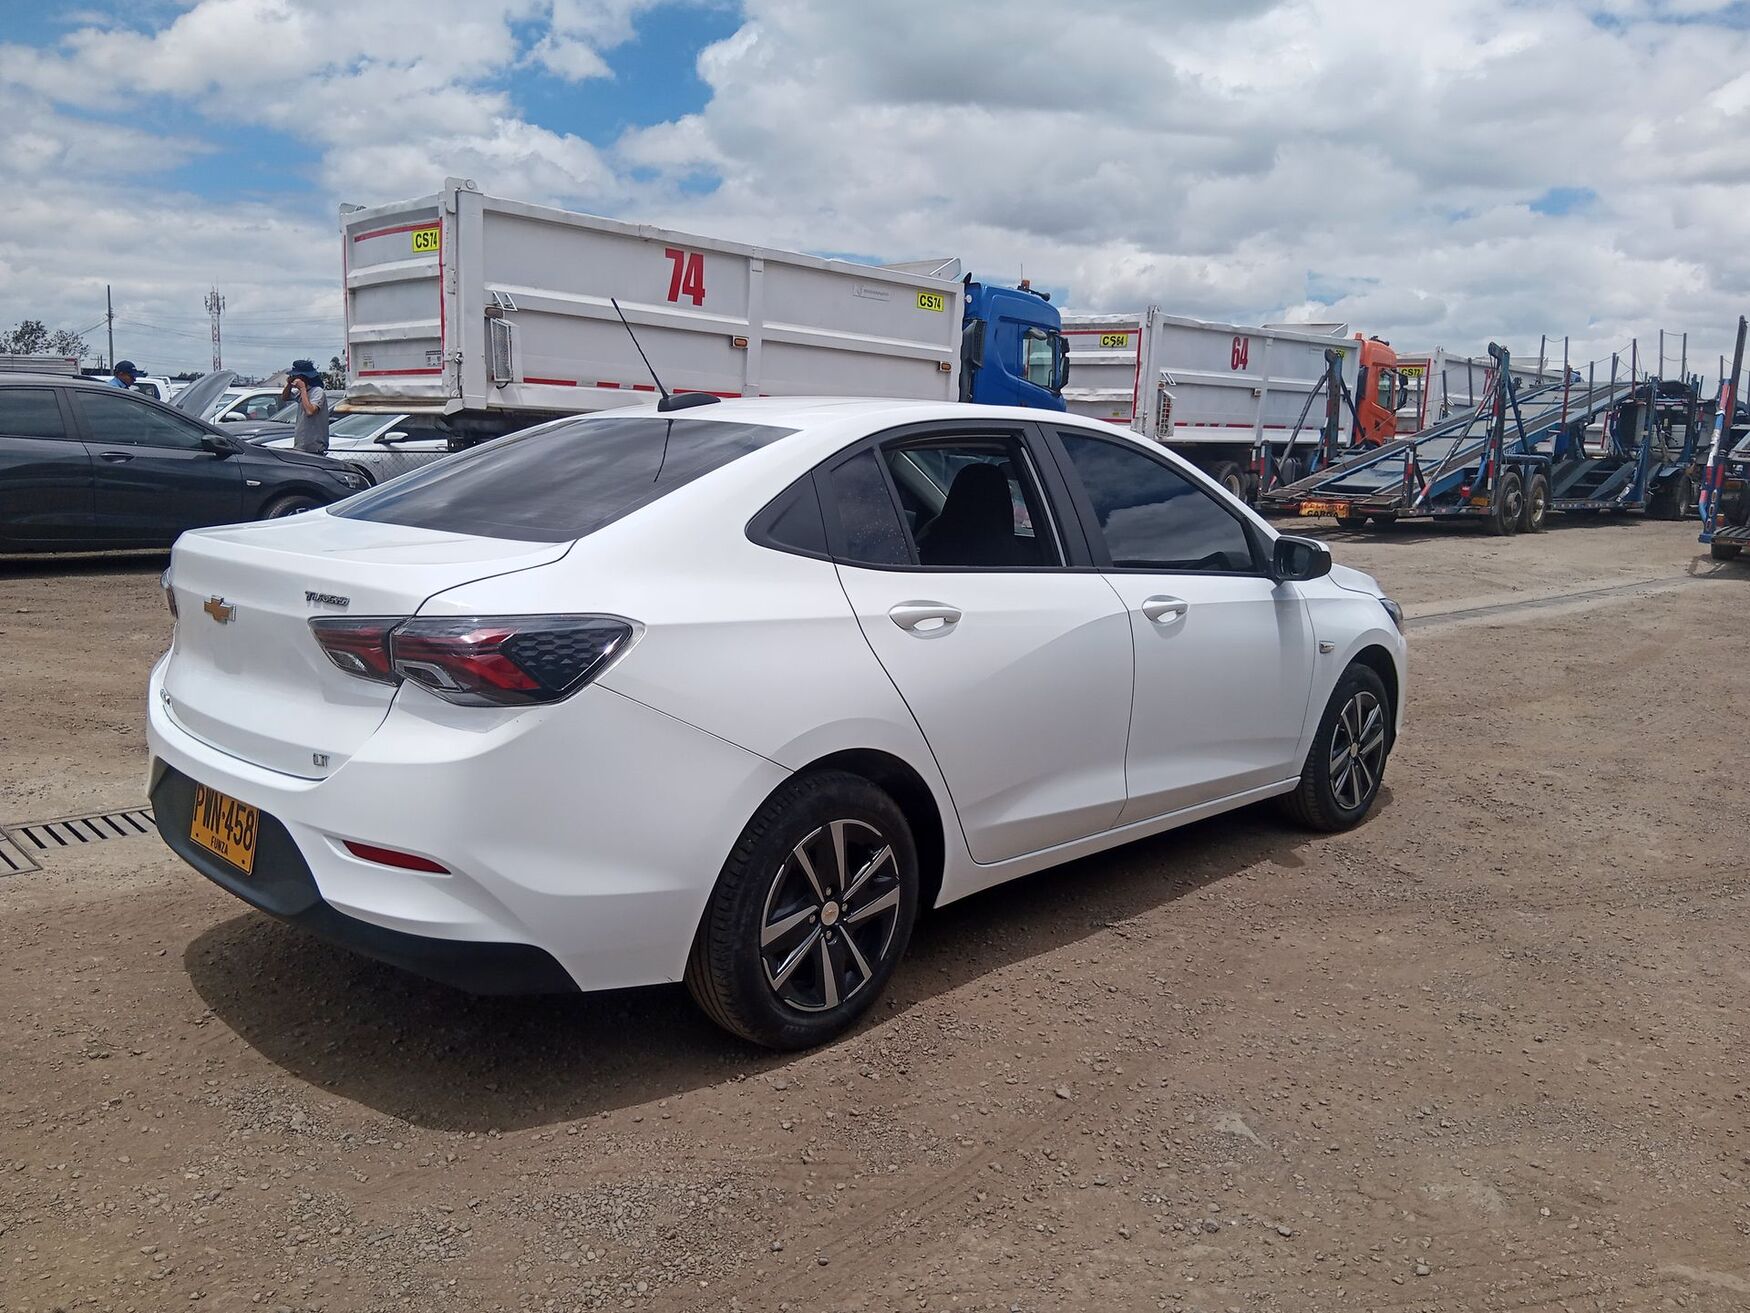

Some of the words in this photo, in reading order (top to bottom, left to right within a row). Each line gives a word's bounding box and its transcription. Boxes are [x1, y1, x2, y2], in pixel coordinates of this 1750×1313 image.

[415, 232, 438, 248] CS74
[665, 247, 705, 306] 74
[919, 295, 941, 309] CS74
[1231, 336, 1248, 370] 64
[211, 836, 229, 856] FUNZA
